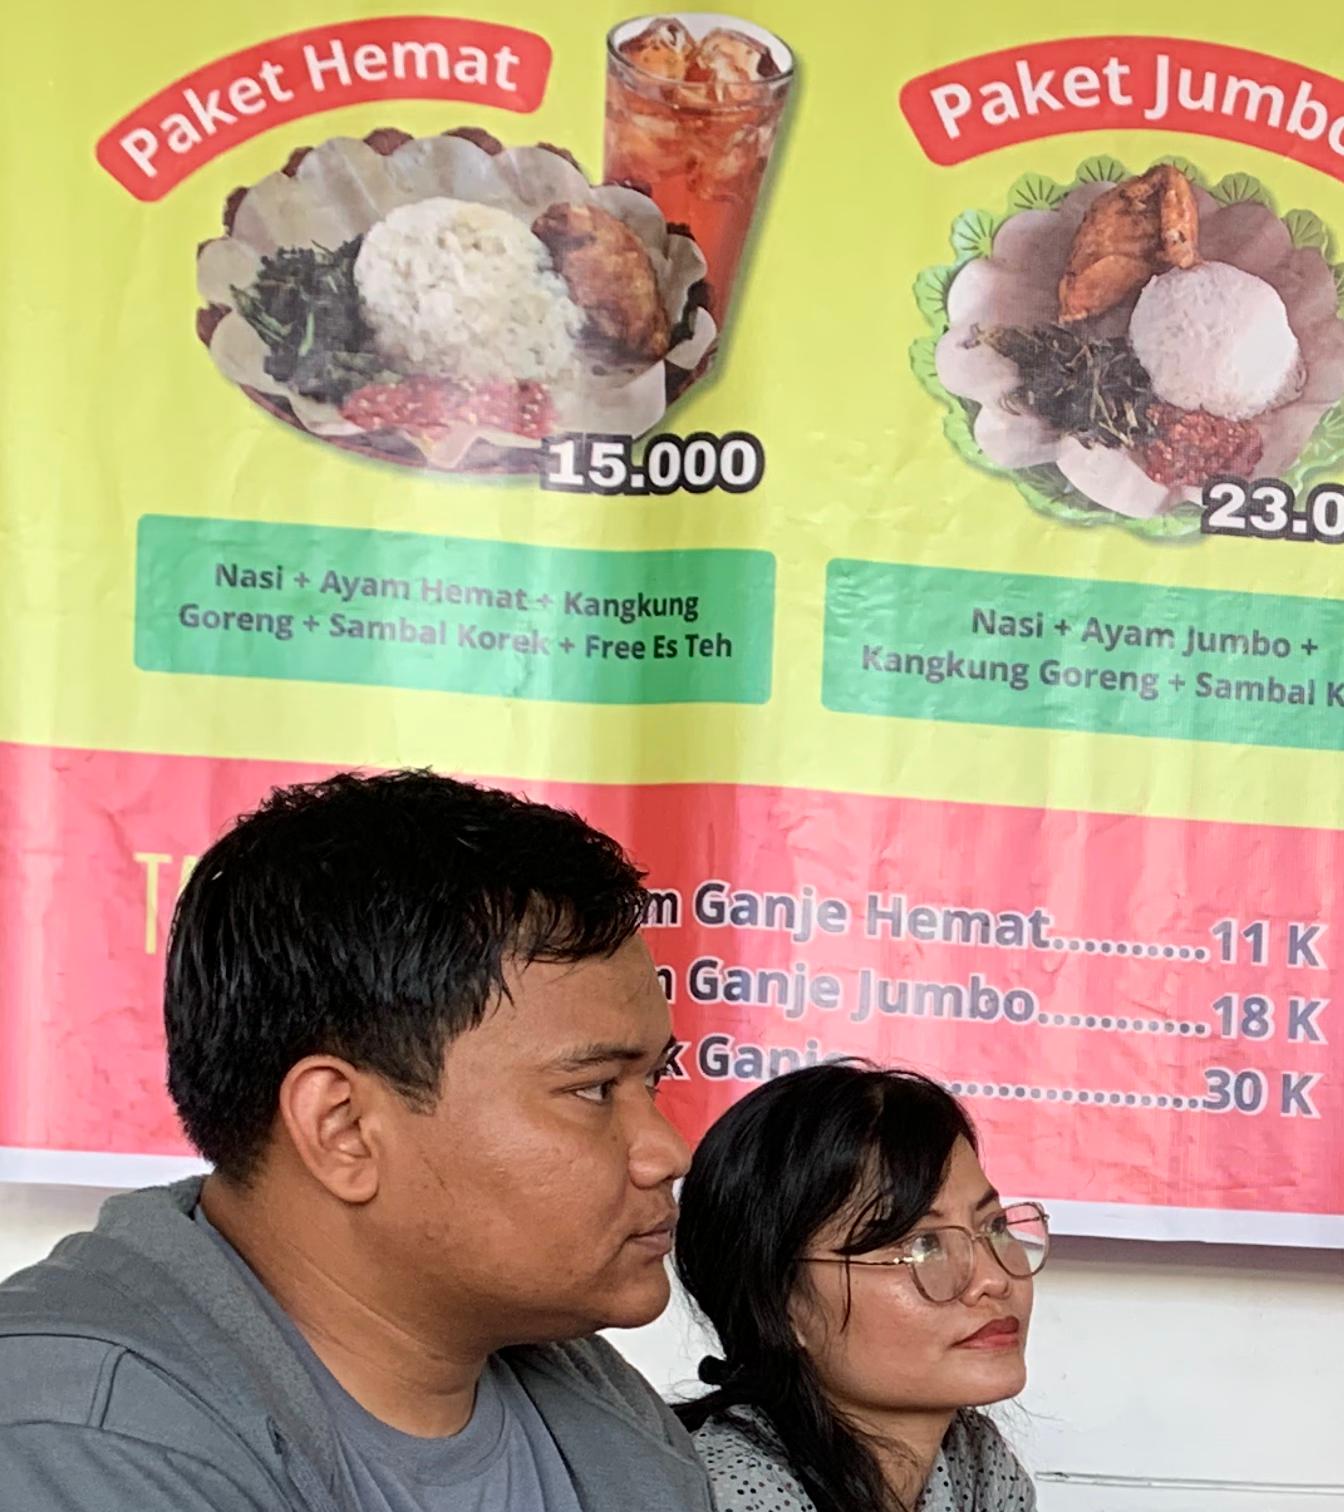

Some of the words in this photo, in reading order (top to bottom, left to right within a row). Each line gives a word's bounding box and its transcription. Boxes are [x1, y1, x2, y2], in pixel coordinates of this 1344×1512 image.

[120, 62, 295, 179] Paket
[302, 41, 520, 94] Hemat
[928, 56, 1132, 139] Paket
[547, 440, 757, 488] 15.000
[214, 561, 284, 590] Nasi
[320, 569, 411, 606] Ayam
[420, 576, 527, 612] Hemat
[563, 590, 700, 624] Kangkung
[178, 602, 294, 641] Goreng
[330, 612, 445, 646] Sambal
[457, 618, 551, 656] Korek
[585, 634, 645, 659] Free
[653, 634, 678, 658] Es
[685, 633, 733, 658] Teh
[971, 608, 1043, 640] Nasi
[1081, 617, 1175, 656] Ayam
[1183, 623, 1291, 660] Jumbo
[861, 645, 1029, 691] Kangkung
[1039, 659, 1159, 700] Goreng
[1195, 671, 1315, 707] Sambal
[693, 880, 849, 942] Ganje
[1285, 922, 1328, 970] K
[687, 956, 841, 1021] Ganje
[1286, 995, 1328, 1045] K
[1279, 1070, 1322, 1119] K
